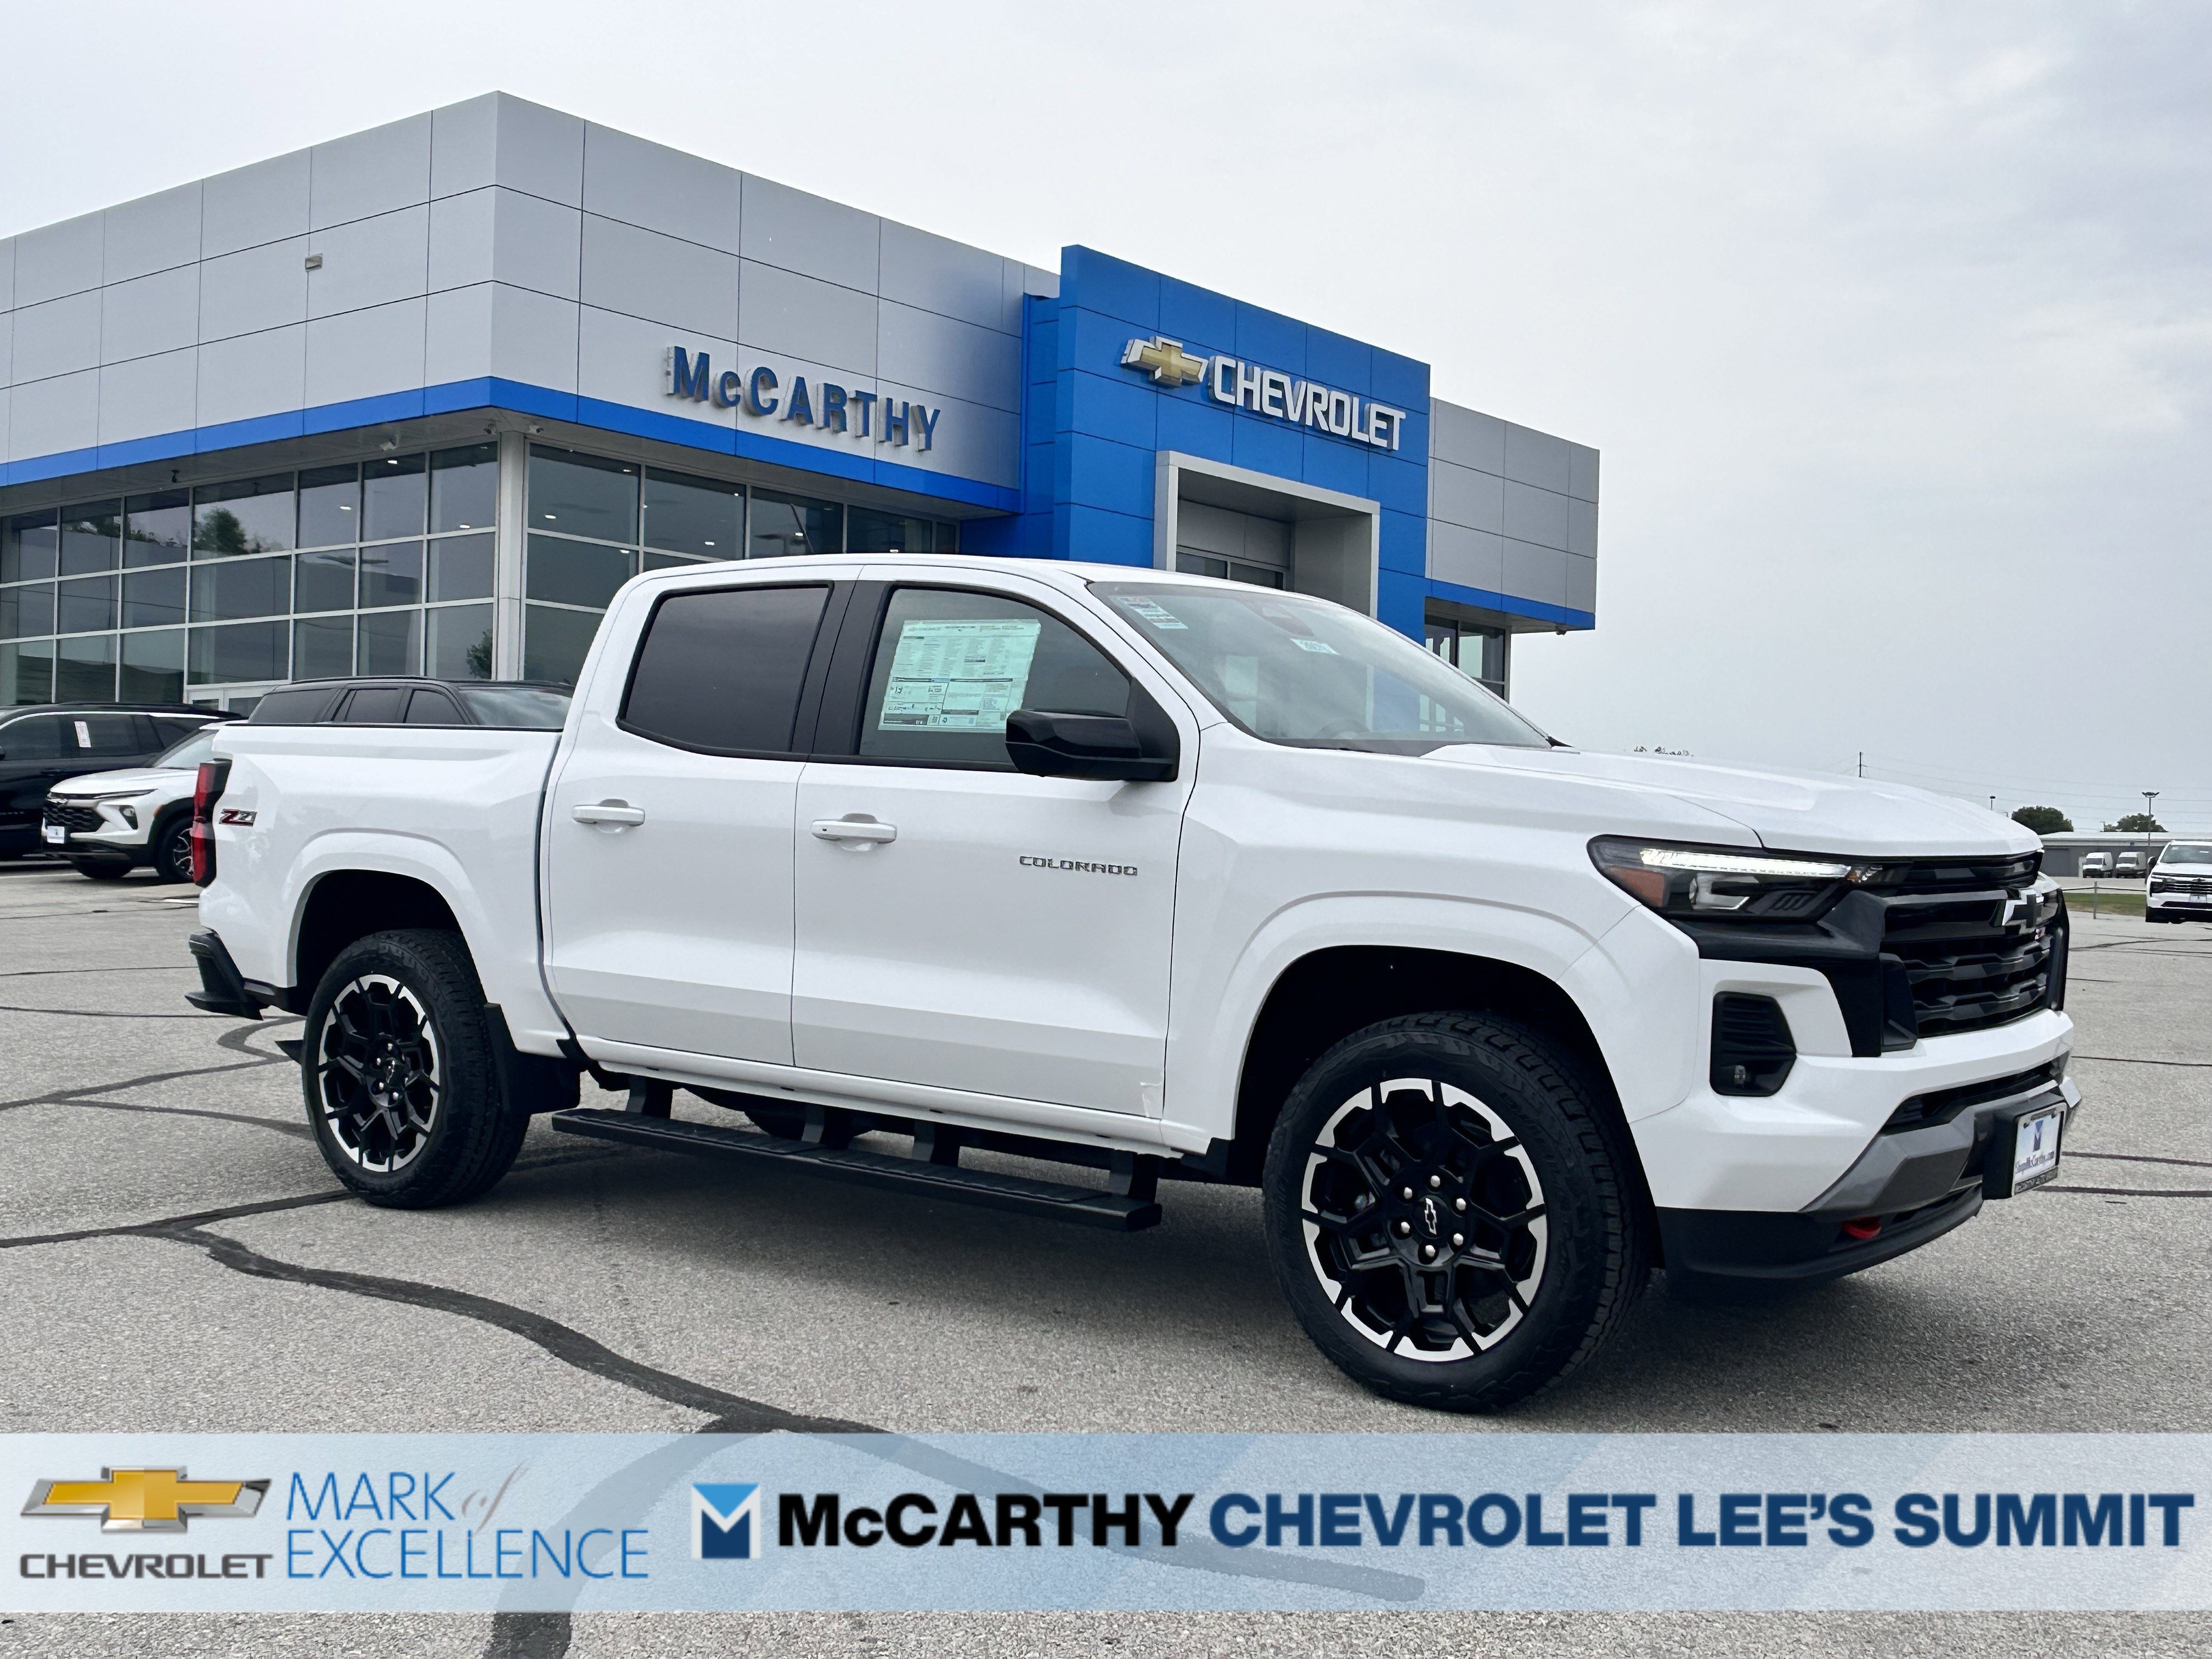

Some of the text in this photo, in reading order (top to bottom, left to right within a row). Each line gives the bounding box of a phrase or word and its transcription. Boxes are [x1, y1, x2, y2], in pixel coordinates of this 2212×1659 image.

[665, 346, 941, 452] McCARTHY
[1209, 356, 1406, 451] CHEVROLET
[1019, 855, 1138, 876] COLORADO
